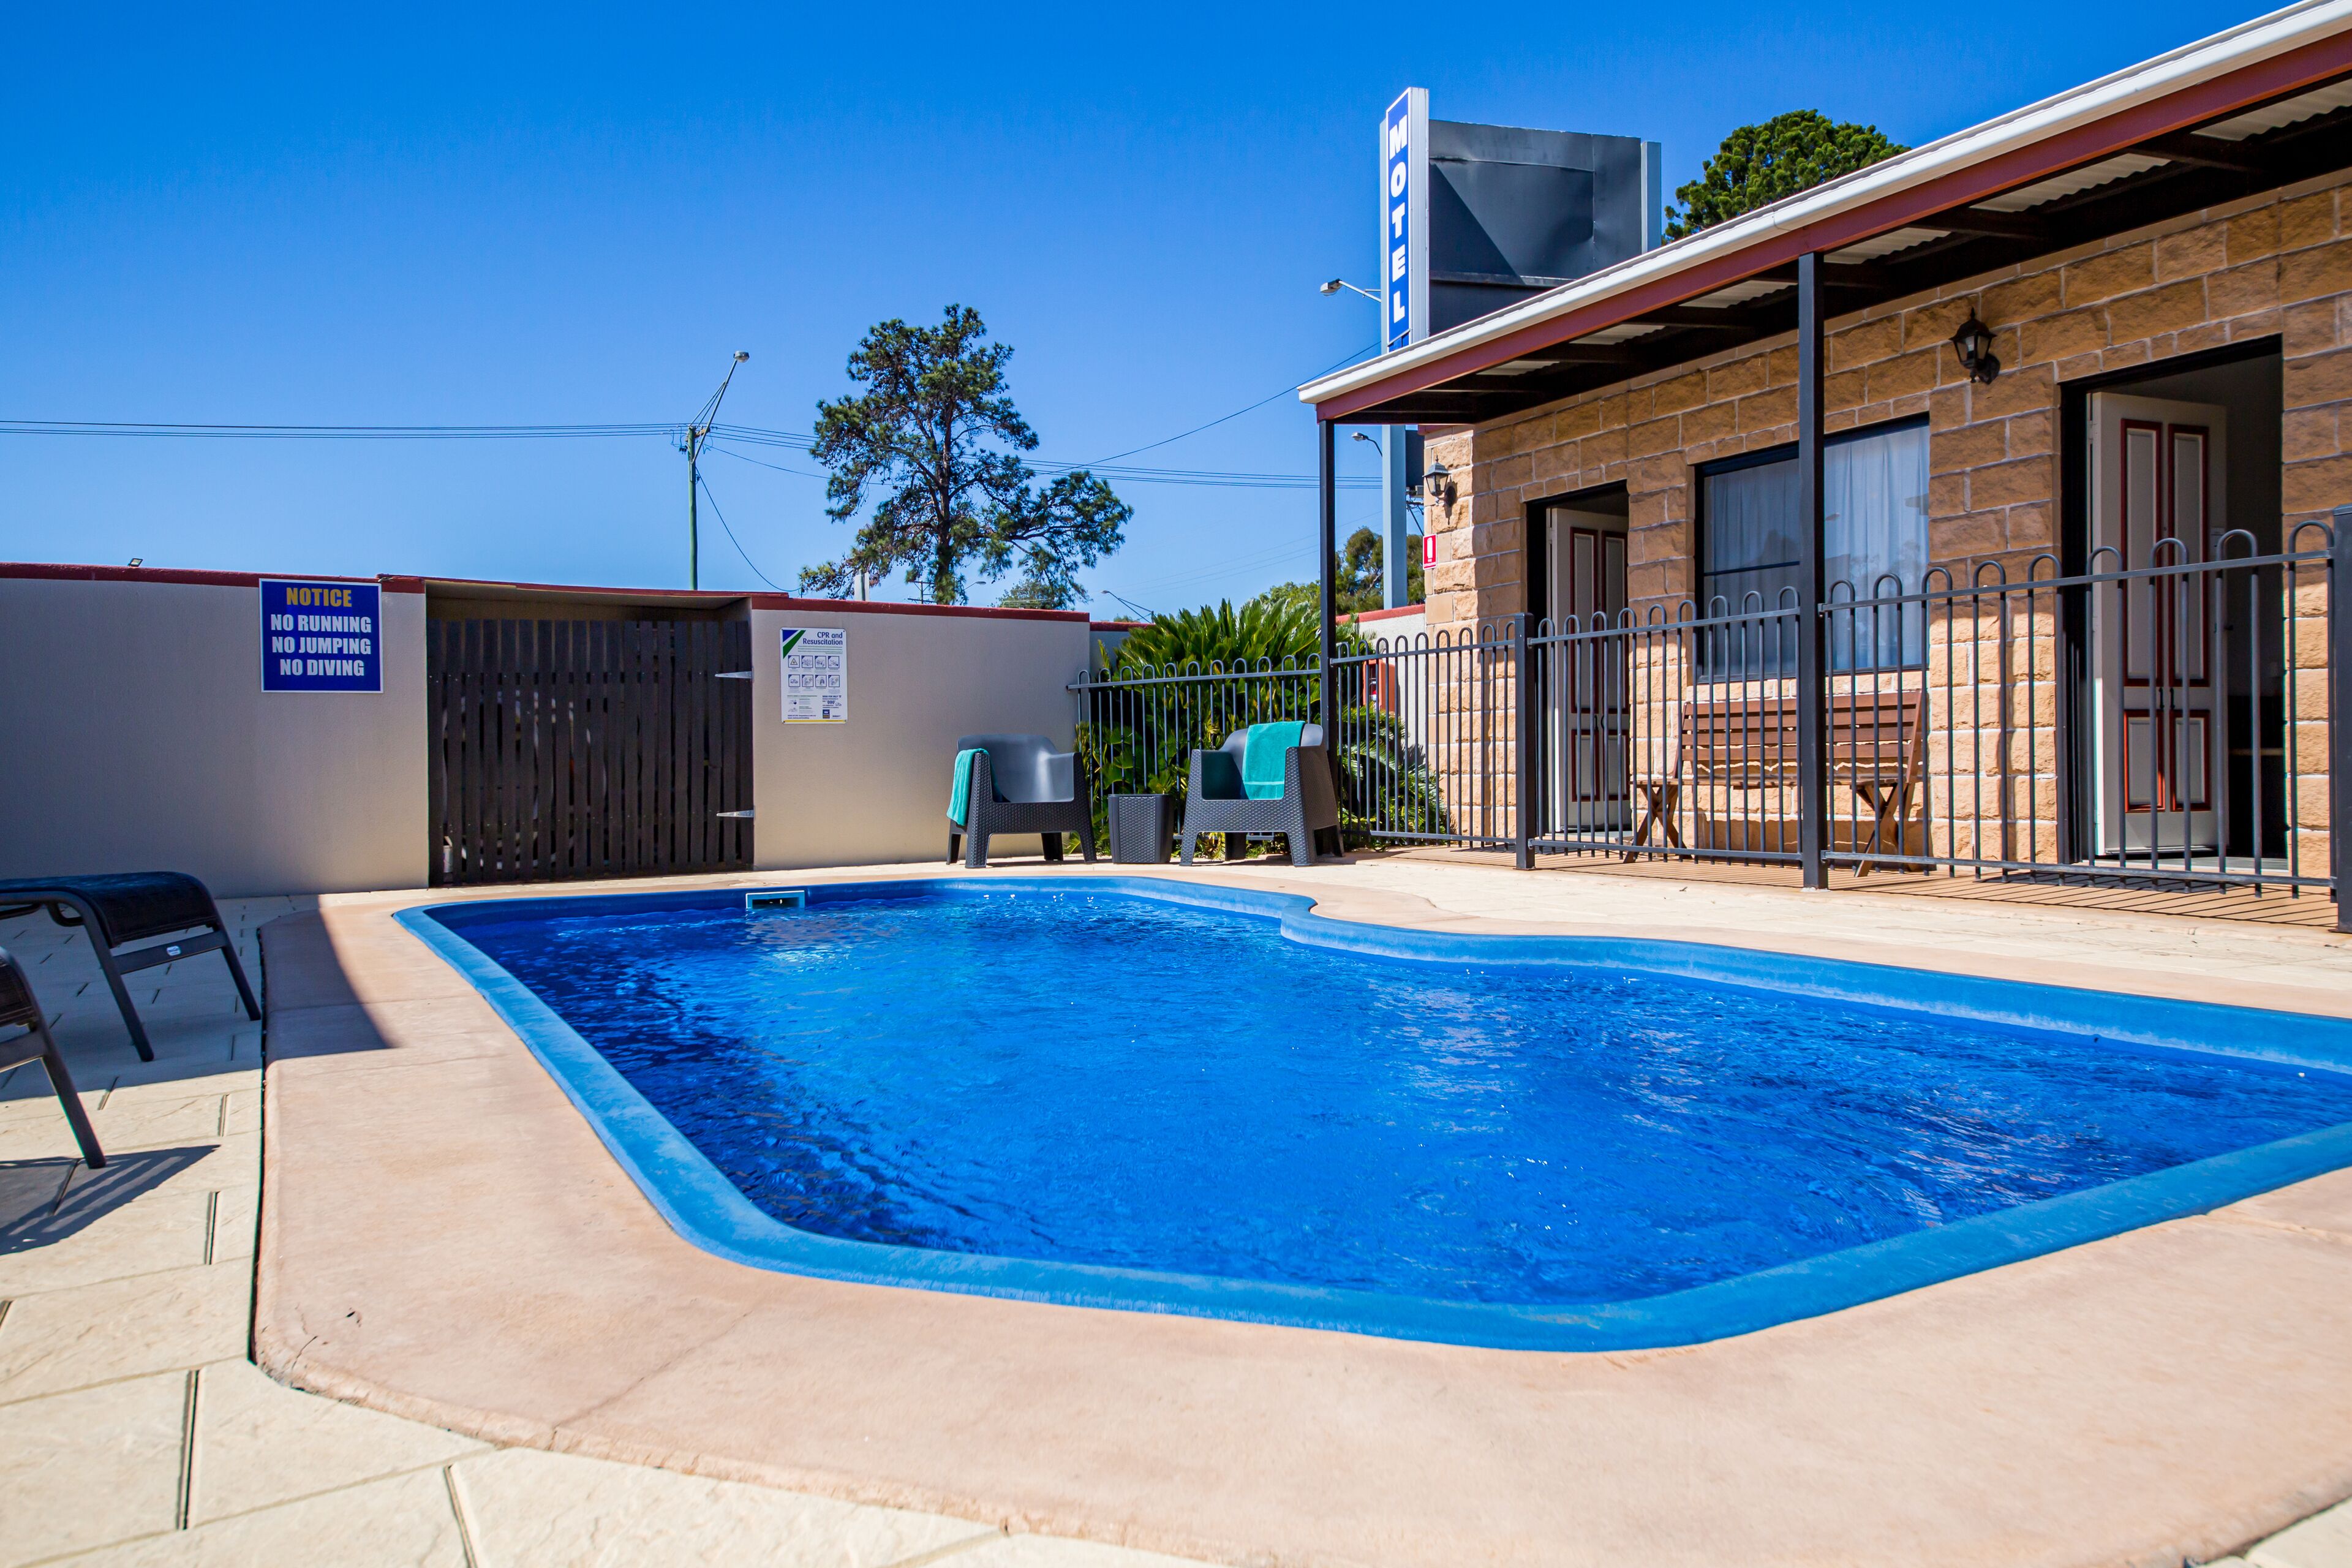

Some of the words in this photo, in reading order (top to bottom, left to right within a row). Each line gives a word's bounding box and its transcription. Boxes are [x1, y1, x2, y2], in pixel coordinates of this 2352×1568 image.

[1389, 115, 1407, 323] MOTEL
[286, 587, 352, 607] NOTICE
[271, 614, 294, 631] NO
[298, 615, 371, 633] RUNNING
[272, 636, 295, 654] NO
[299, 637, 371, 655] JUMPING
[280, 658, 303, 676] NO
[307, 659, 364, 676] DIVING
